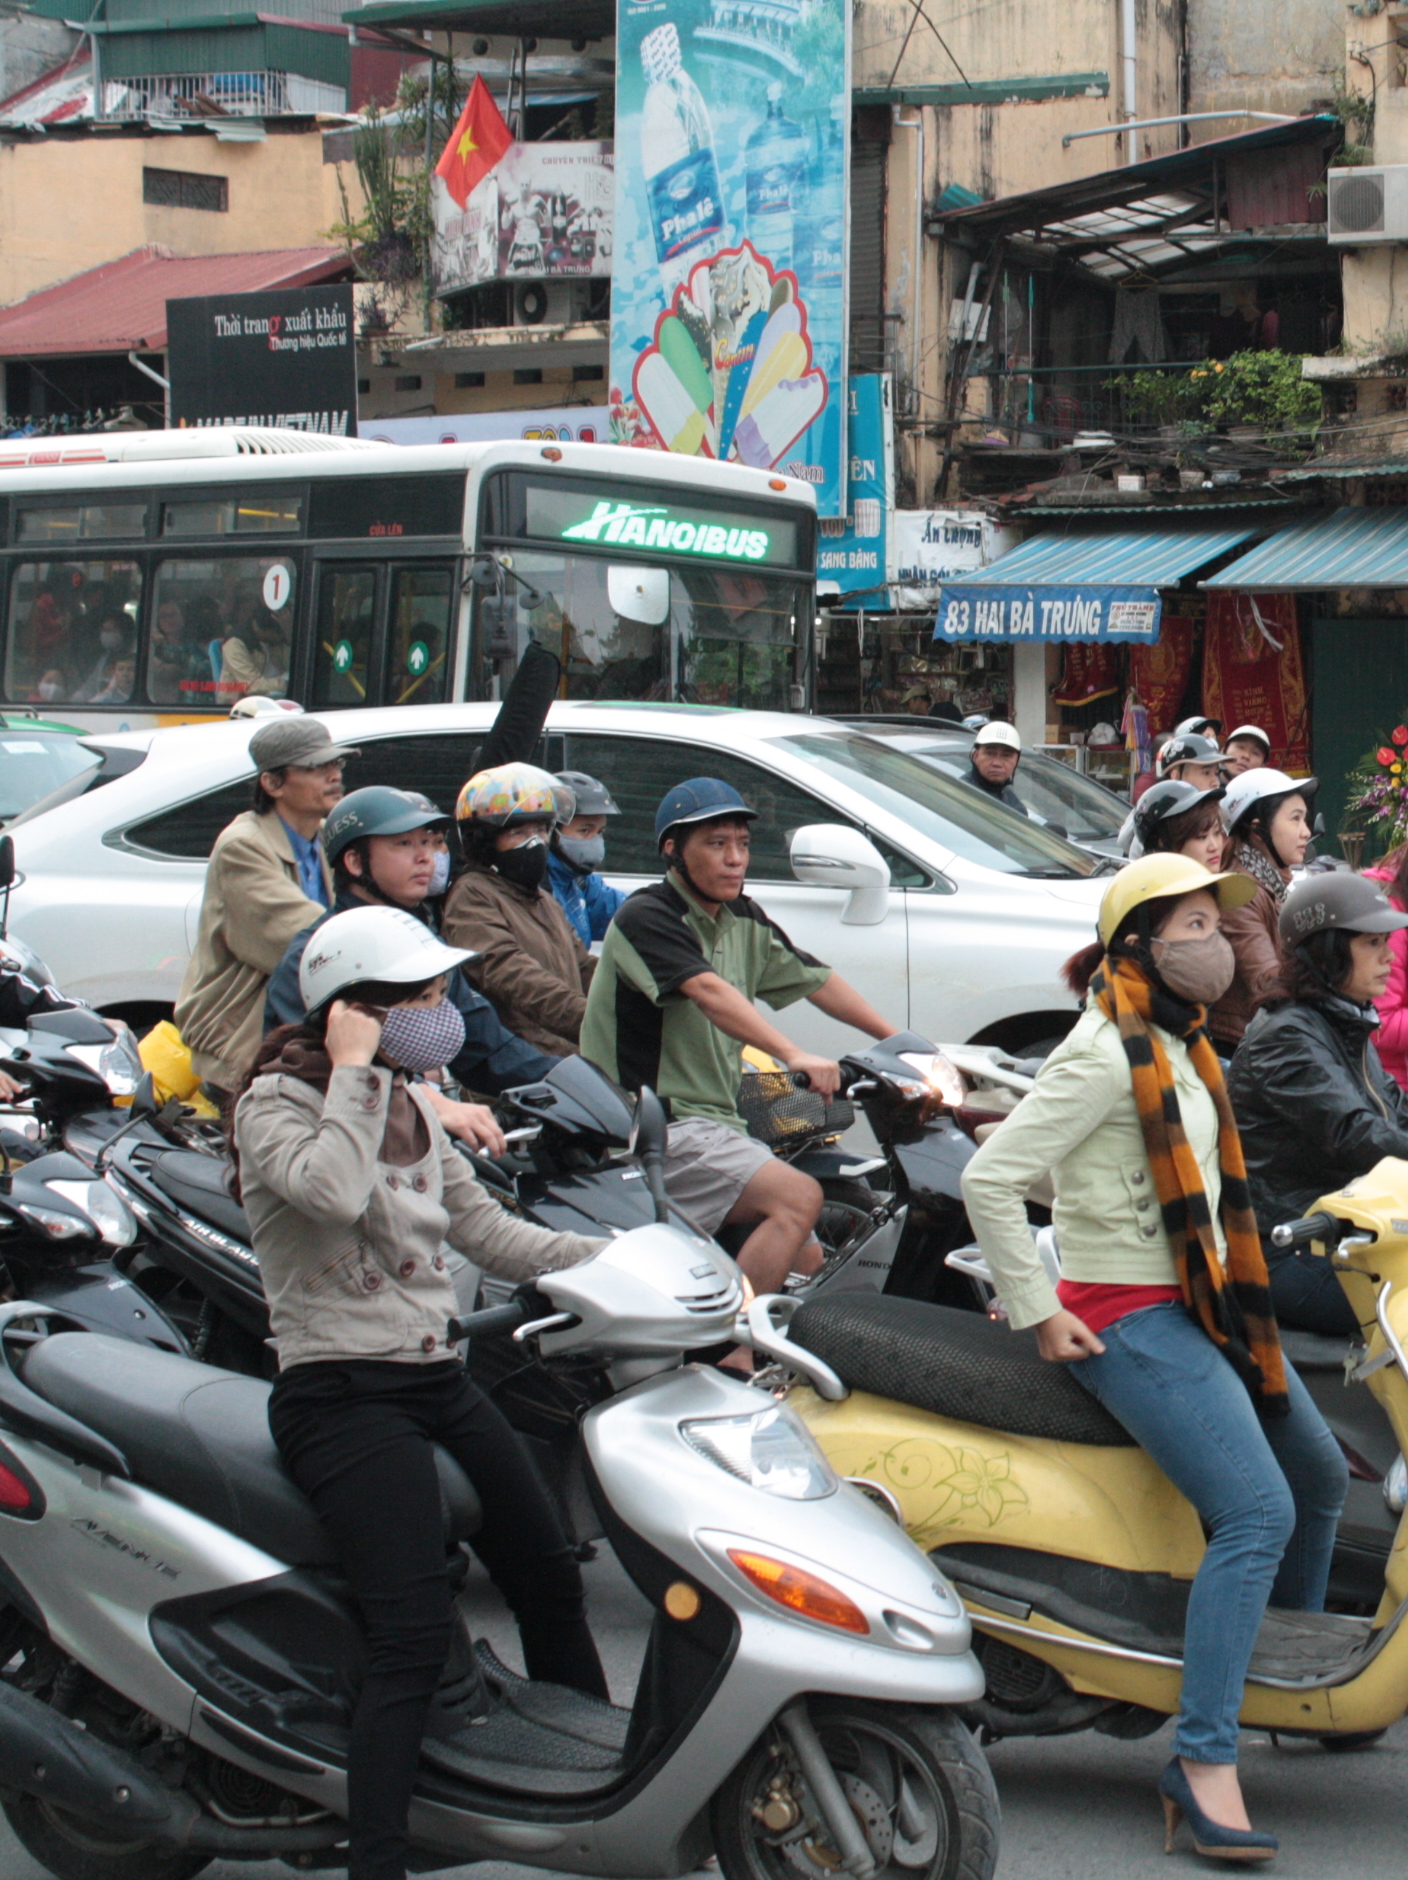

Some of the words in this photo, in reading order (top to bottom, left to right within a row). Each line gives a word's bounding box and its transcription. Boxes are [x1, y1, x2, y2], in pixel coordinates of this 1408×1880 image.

[215, 313, 241, 337] Thời
[244, 315, 282, 350] trang
[285, 307, 312, 332] xuất
[315, 302, 347, 330] khẩu
[299, 334, 316, 351] hiệu
[317, 331, 338, 347] Quốc
[338, 329, 347, 346] tế
[787, 460, 825, 484] Nam
[562, 501, 768, 559] HANOIBUS
[820, 551, 847, 568] SANG
[271, 574, 281, 601] 1
[944, 600, 970, 634] 83
[974, 601, 1005, 635] HAI
[1009, 591, 1034, 635] BÀ
[1040, 594, 1102, 635] TRƯNG
[857, 1259, 892, 1270] HOND
